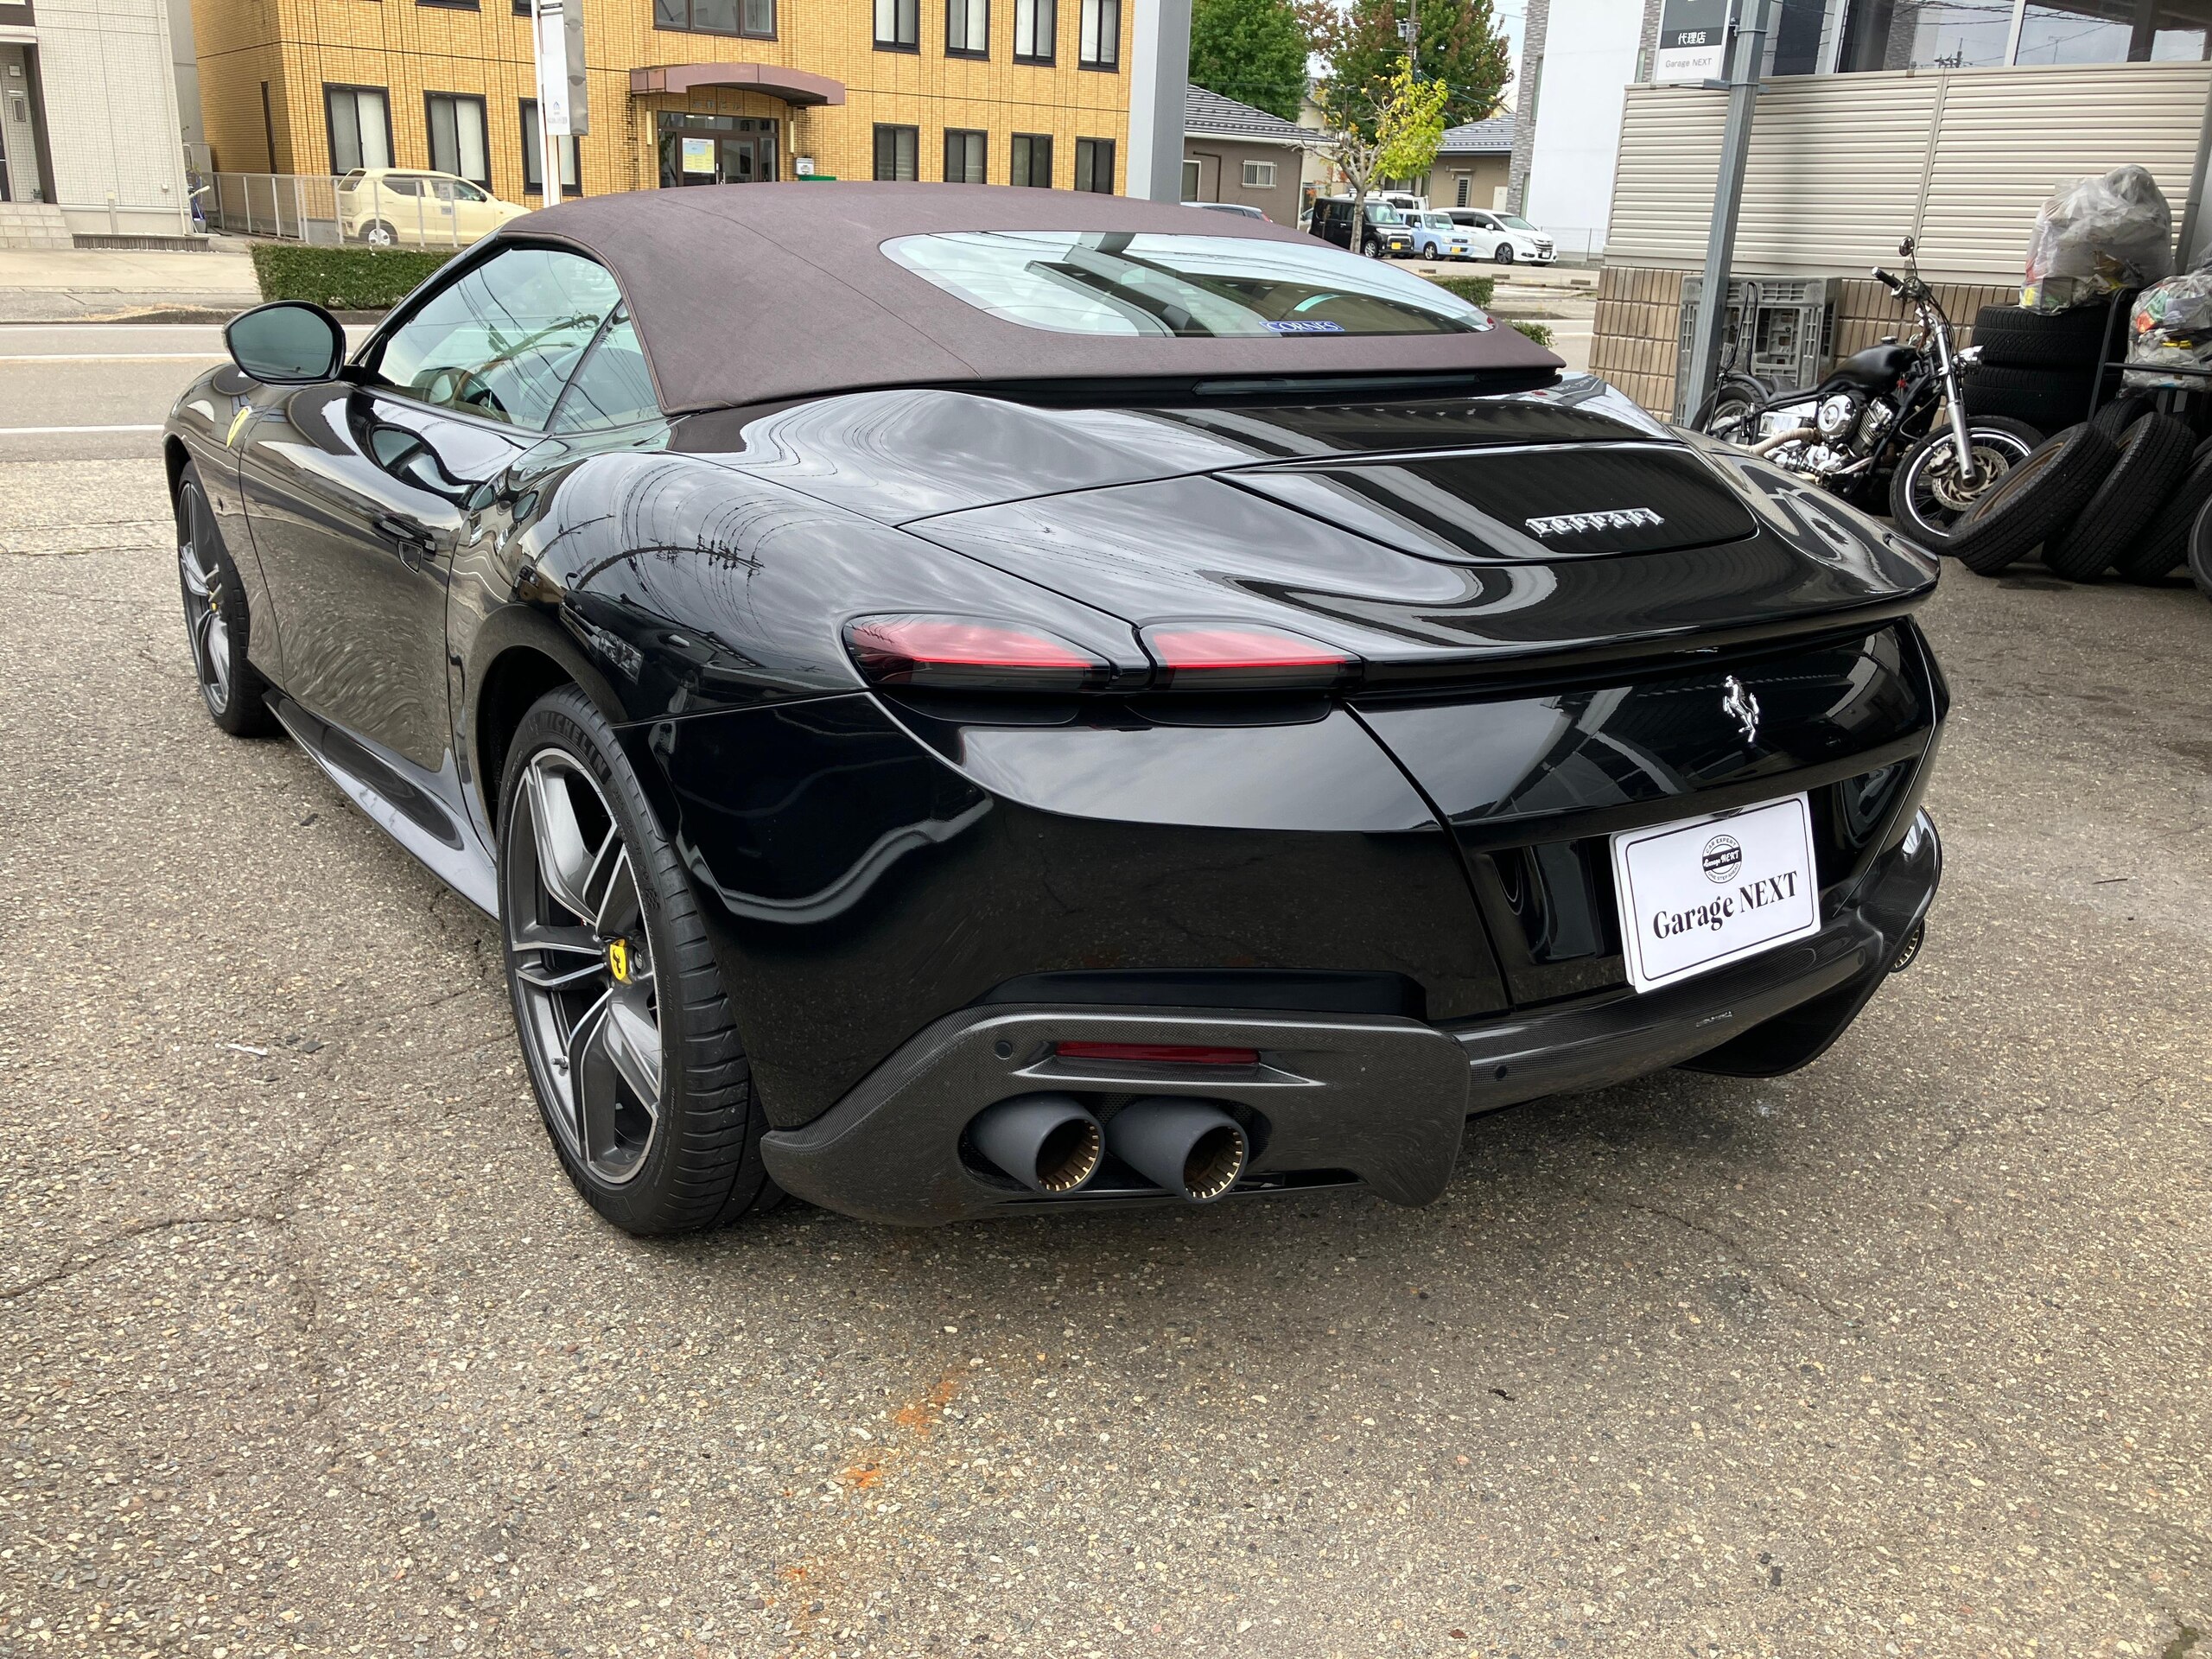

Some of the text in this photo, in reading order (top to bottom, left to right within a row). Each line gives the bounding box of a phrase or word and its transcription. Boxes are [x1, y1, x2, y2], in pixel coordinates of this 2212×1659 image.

[1677, 31, 1707, 45] 代理店
[1665, 58, 1713, 68] Garage NEXT
[1525, 506, 1665, 538] Ferrari
[537, 710, 609, 778] MICHELIN
[1706, 837, 1737, 854] CAR EXPERT
[1720, 849, 1740, 863] NEXT
[1708, 871, 1718, 880] ONE
[1653, 870, 1798, 939] Garage NEXT
